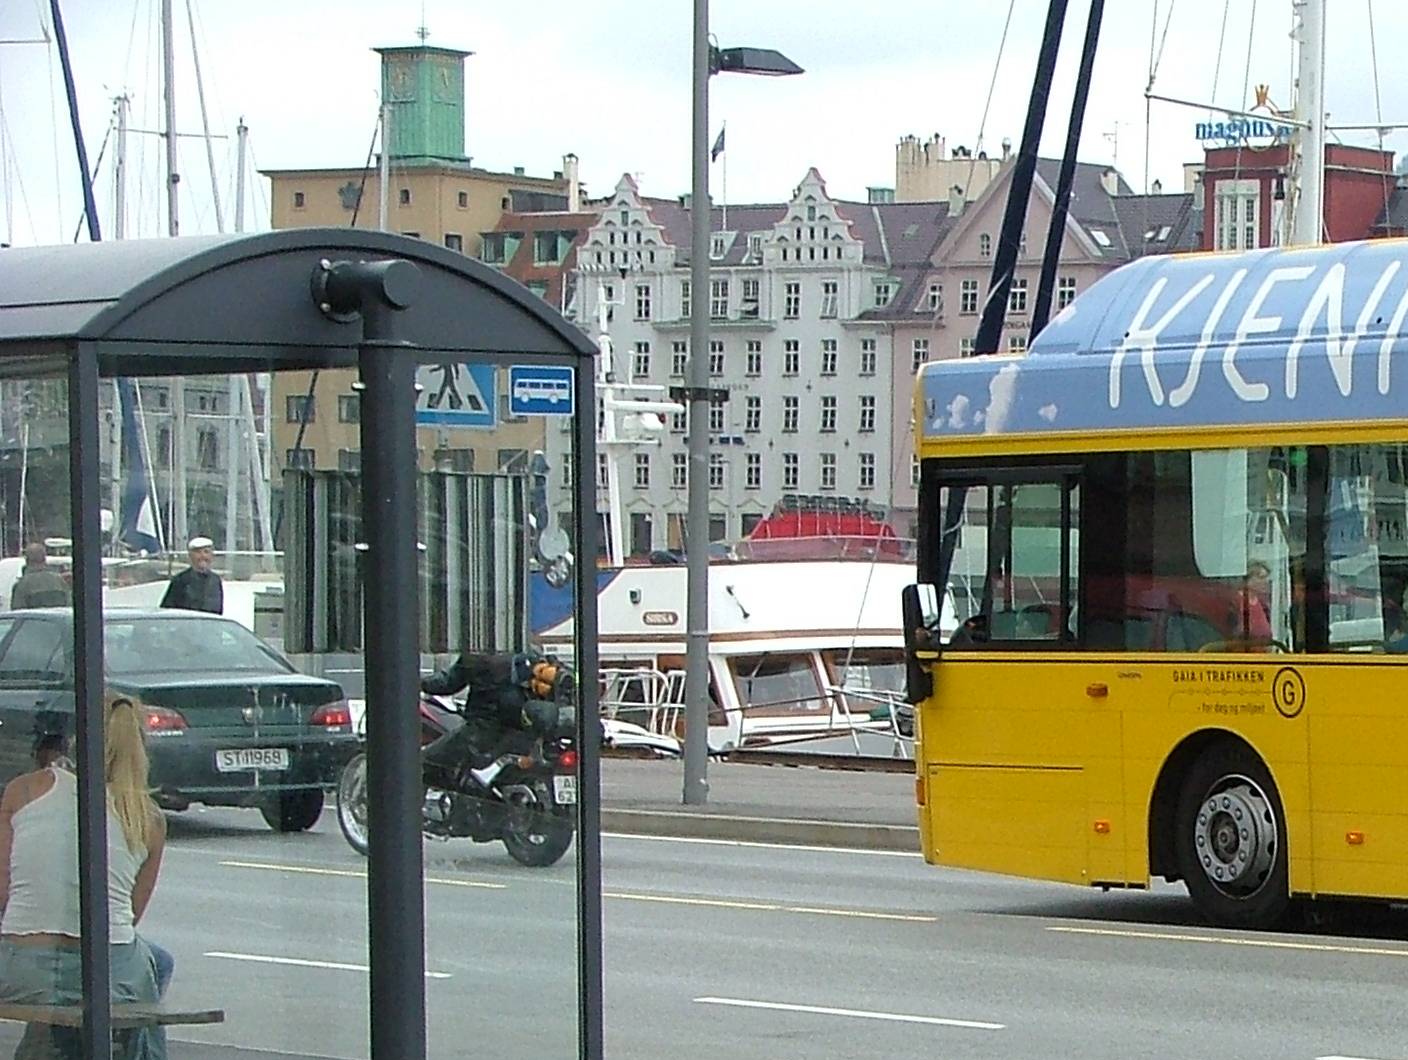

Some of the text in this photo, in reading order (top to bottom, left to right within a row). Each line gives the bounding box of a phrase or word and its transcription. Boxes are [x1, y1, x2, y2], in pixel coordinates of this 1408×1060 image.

[1195, 117, 1276, 144] magnus
[1172, 669, 1197, 683] GAIA
[1206, 669, 1265, 684] TRAFIKKEN
[1282, 680, 1296, 706] G
